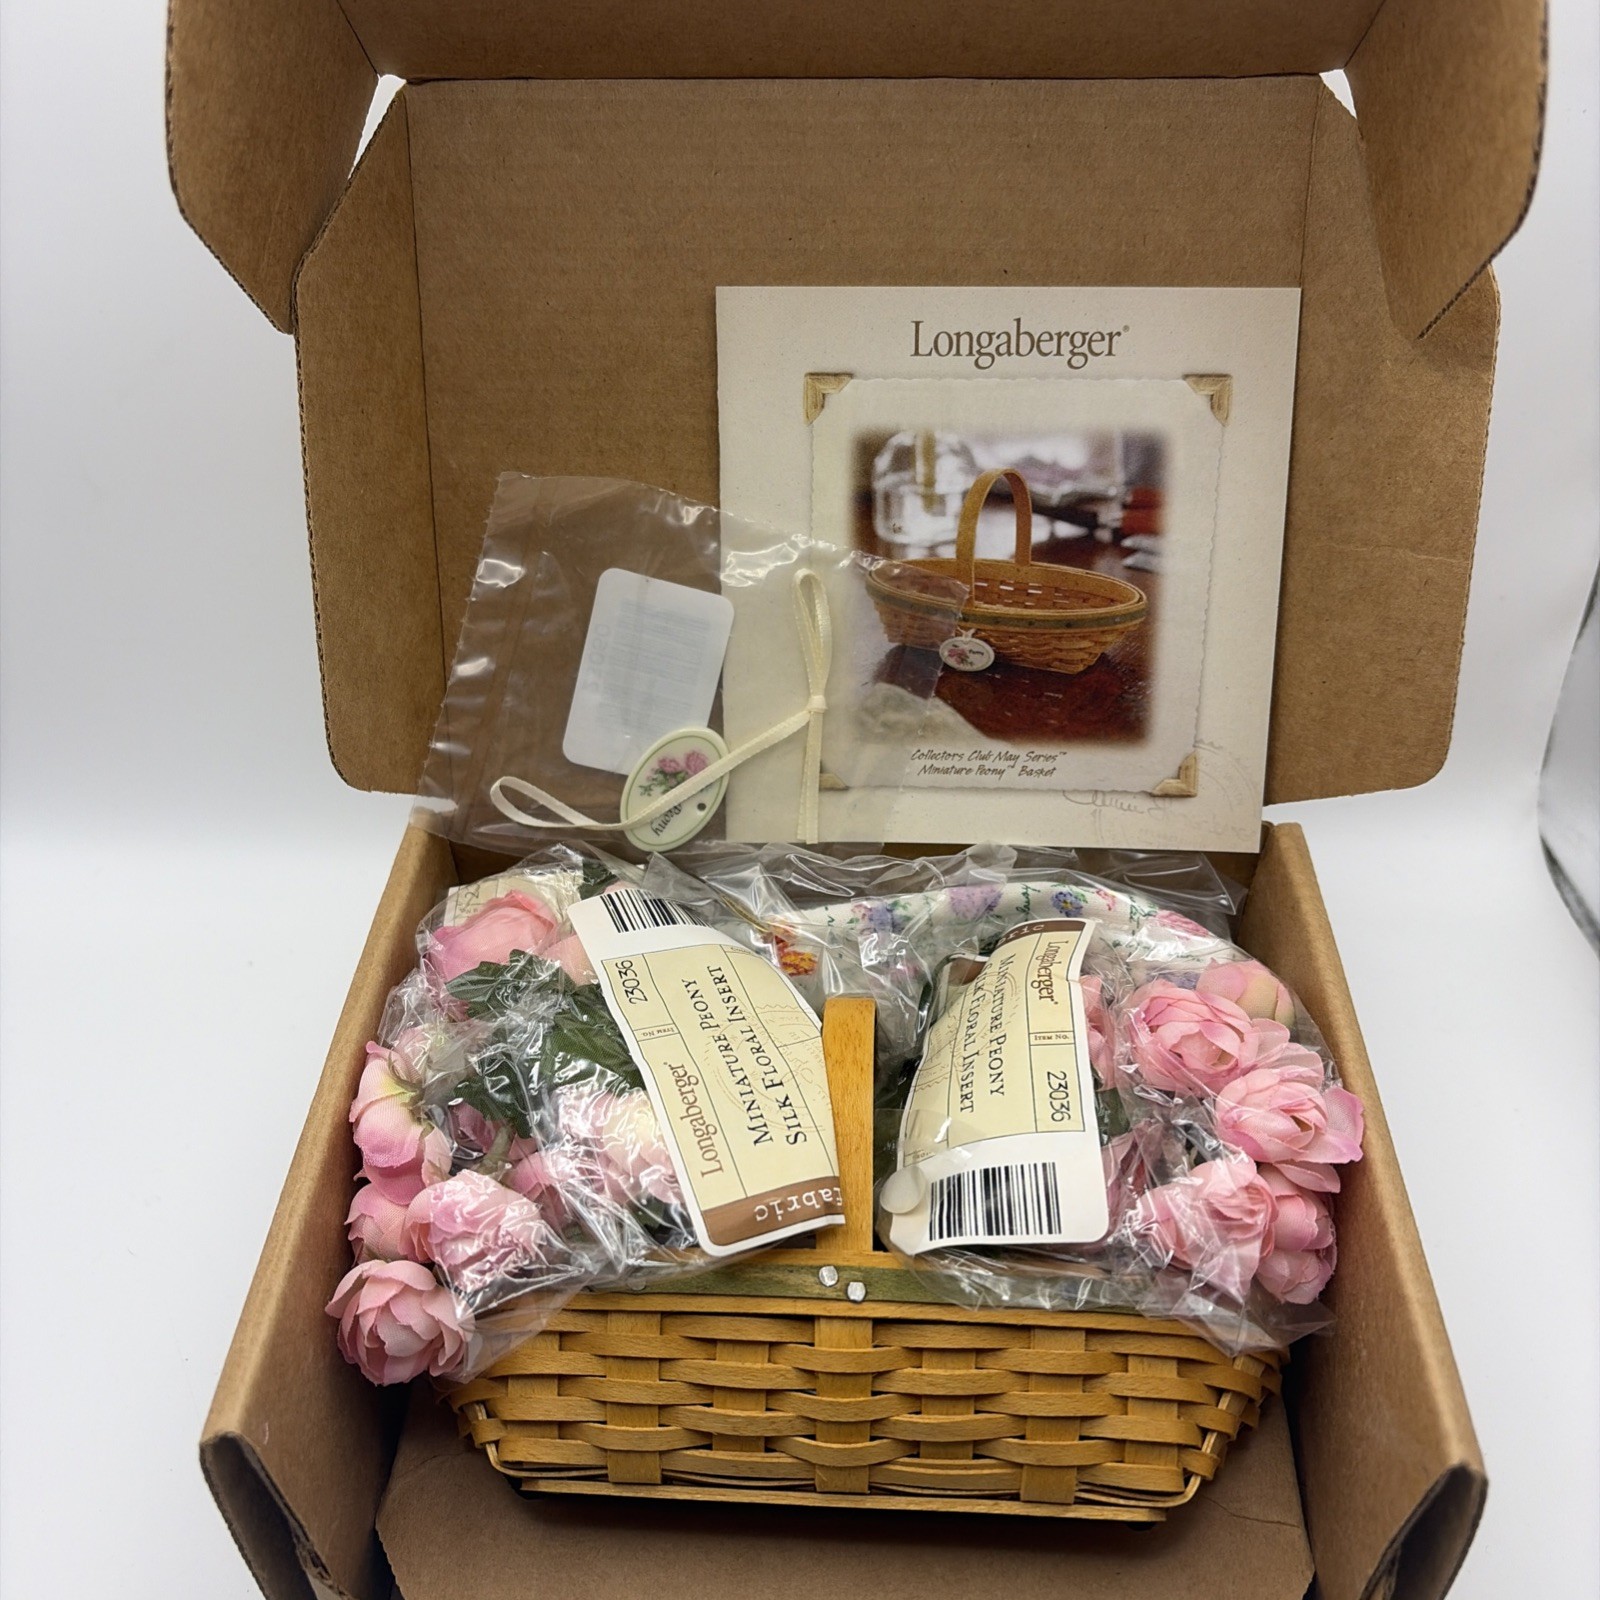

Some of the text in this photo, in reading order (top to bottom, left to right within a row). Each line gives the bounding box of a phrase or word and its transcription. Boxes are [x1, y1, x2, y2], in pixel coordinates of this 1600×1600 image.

[910, 749, 965, 762] Collectors
[967, 750, 994, 762] Club
[992, 751, 1020, 766] May
[917, 764, 973, 776] Miniature
[1018, 765, 1057, 778] Basket
[615, 959, 648, 1004] 23036
[706, 965, 746, 1023] INSERT
[963, 995, 986, 1052] FLORAL
[988, 953, 1017, 1096] MINIATURE PEONY
[681, 978, 773, 1147] MINIATURE PEONY
[739, 1024, 784, 1090] FLORAL
[959, 1050, 980, 1113] INSERT
[775, 1094, 807, 1146] SILK
[1046, 1070, 1072, 1123] 23036
[753, 1186, 842, 1222] fabric
